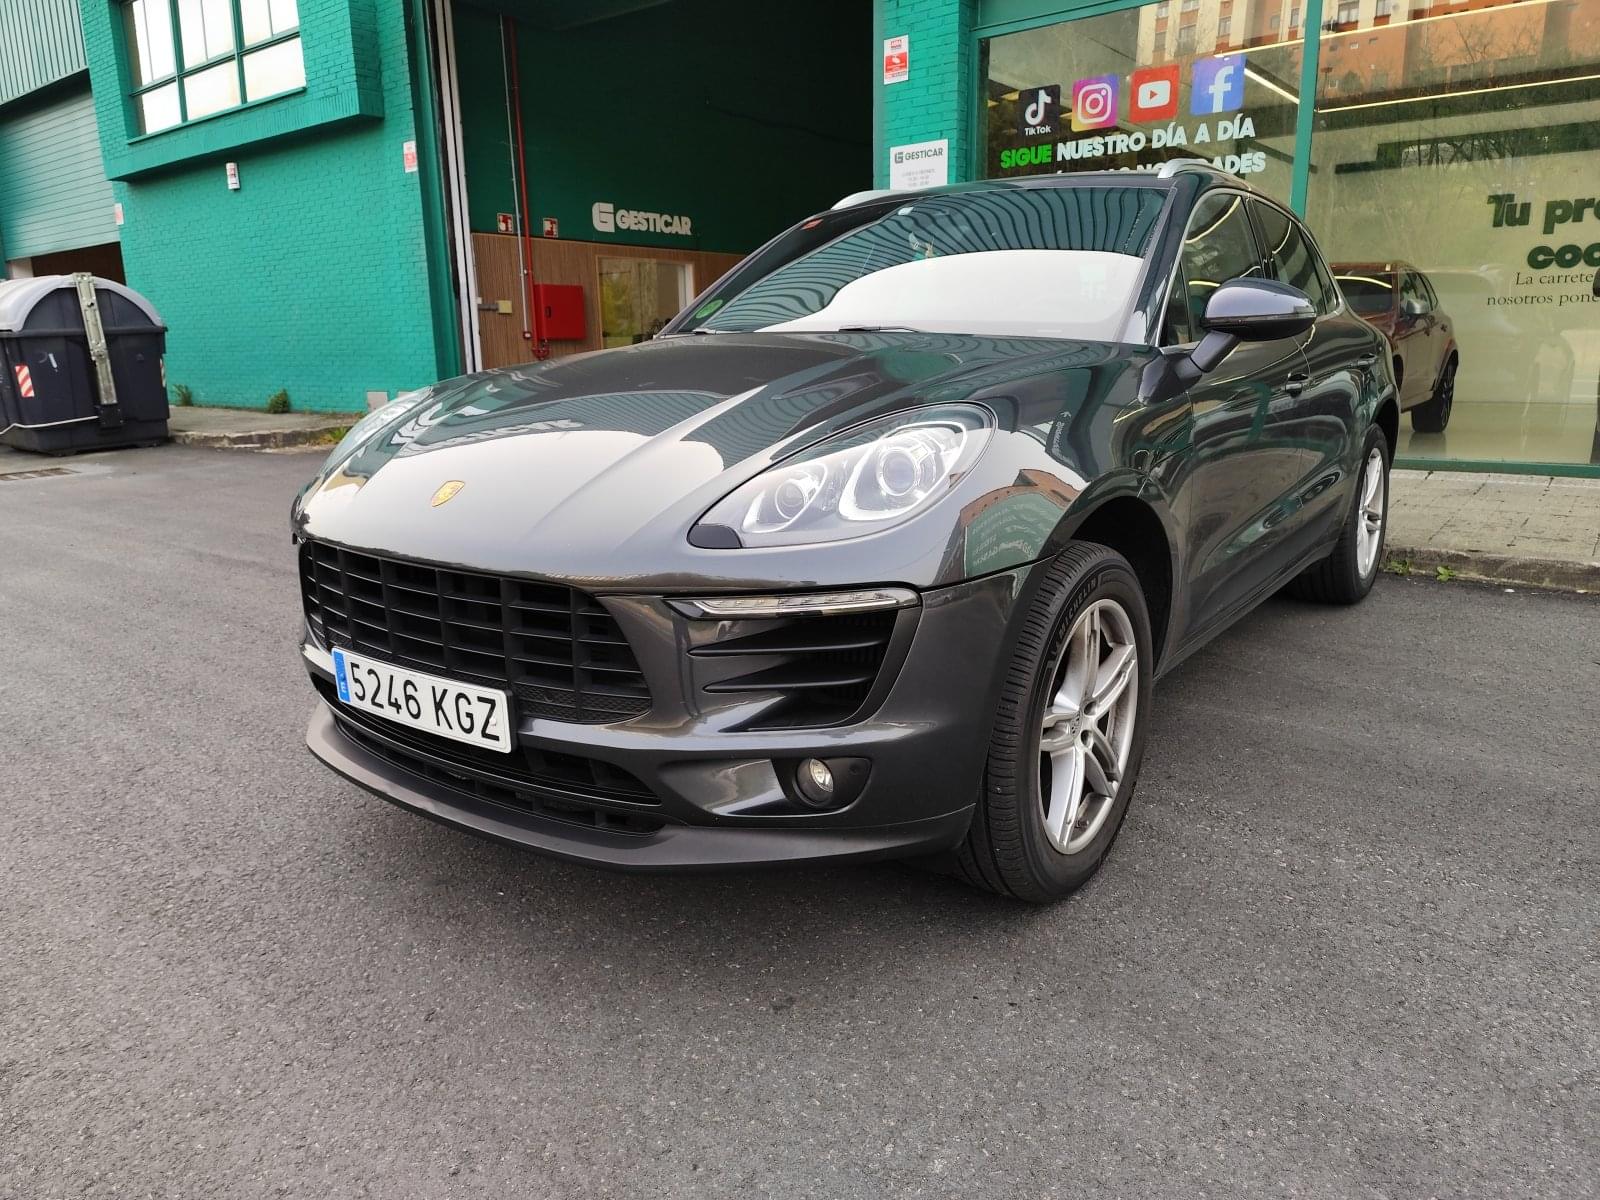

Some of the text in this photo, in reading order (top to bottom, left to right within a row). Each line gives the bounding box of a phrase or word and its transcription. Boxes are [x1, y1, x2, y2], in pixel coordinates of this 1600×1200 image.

[1024, 124, 1052, 136] TikTok
[1000, 113, 1256, 169] SIGUE NUESTRO DÍA A DÍA
[904, 147, 943, 162] GESTICAR
[615, 208, 693, 236] GESTICAR
[1487, 193, 1600, 235] Tu pr
[1515, 271, 1594, 286] La carrete
[1487, 294, 1553, 306] nosotros
[350, 661, 421, 720] 5246
[431, 685, 500, 742] KGZ
